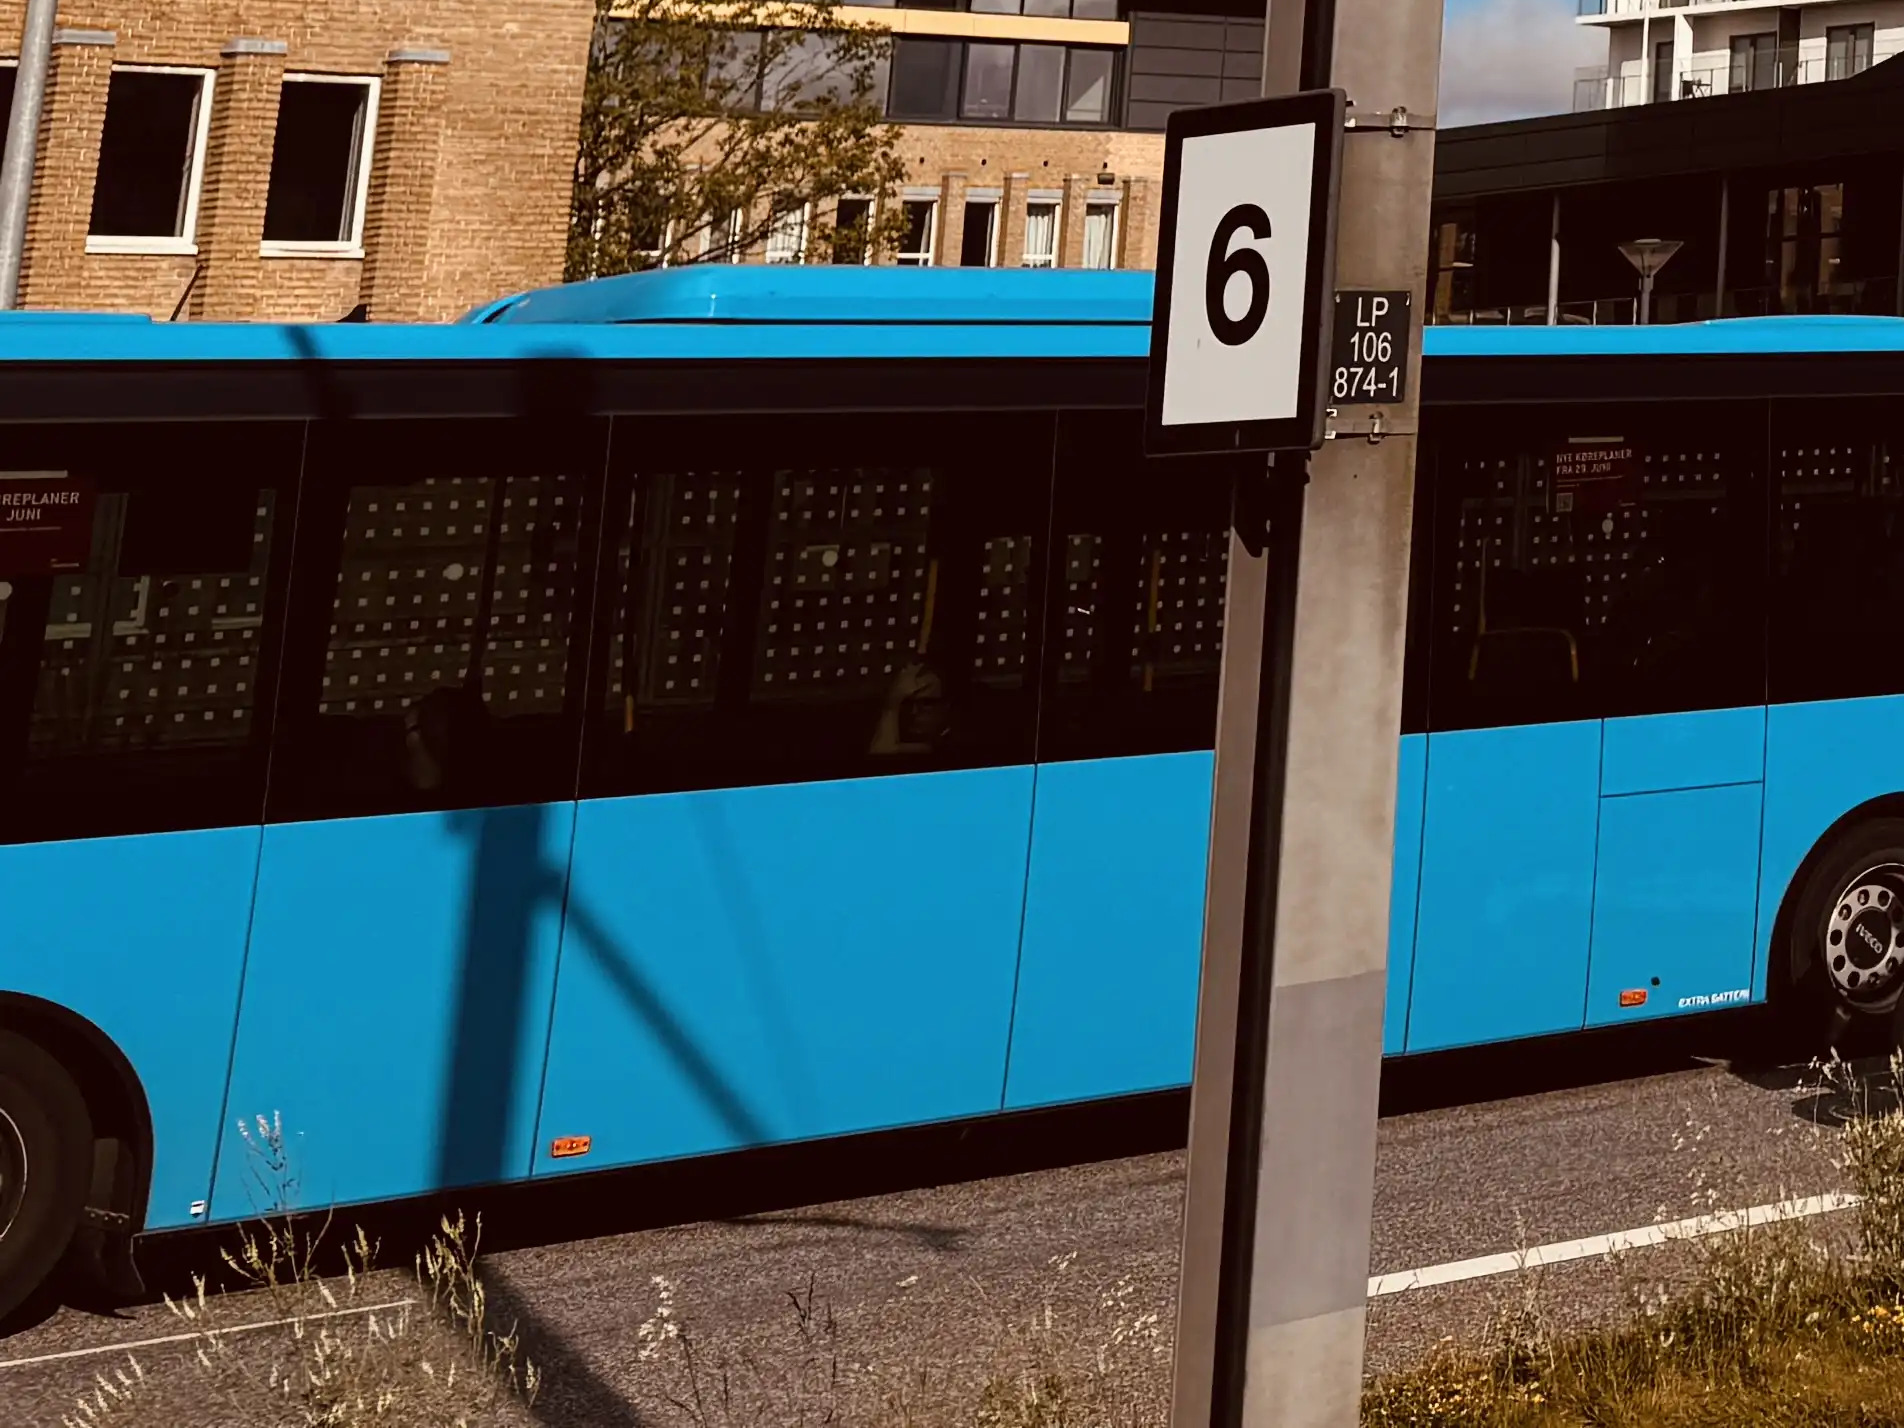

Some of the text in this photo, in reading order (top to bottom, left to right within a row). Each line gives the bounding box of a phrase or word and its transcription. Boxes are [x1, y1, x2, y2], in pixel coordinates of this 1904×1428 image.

[1205, 202, 1272, 347] 6
[1356, 296, 1390, 327] LP
[1350, 331, 1392, 363] 106
[1333, 366, 1399, 398] 874-1
[0, 491, 80, 507] REPLANER
[6, 507, 42, 522] JUNI
